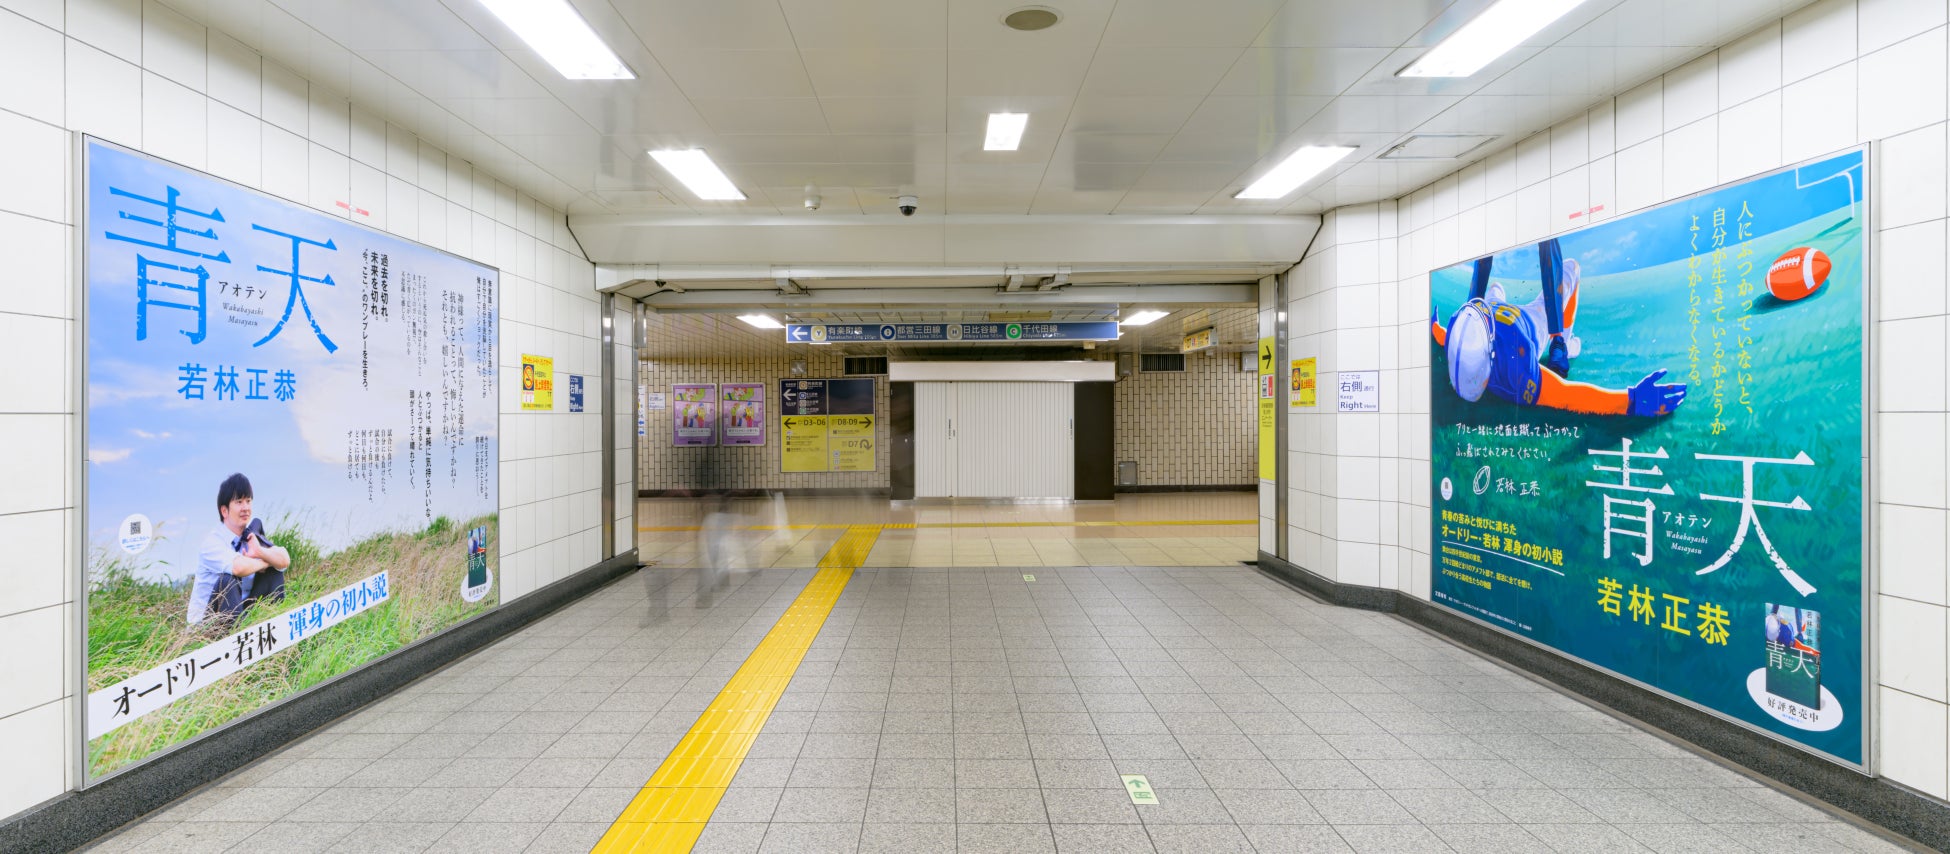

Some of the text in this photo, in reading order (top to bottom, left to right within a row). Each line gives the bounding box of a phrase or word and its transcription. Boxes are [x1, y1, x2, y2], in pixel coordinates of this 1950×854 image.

[105, 185, 338, 354] 青天
[218, 281, 267, 300] アオテン
[371, 251, 379, 320] 未来を切れ。
[222, 302, 264, 316] Wakabayashi
[1688, 215, 1702, 386] よくわからなくなる。
[1737, 201, 1753, 414] 人にぶつかっていないと、
[228, 315, 258, 327] Masayasu
[897, 325, 941, 335] 都営三田線
[963, 325, 998, 334] 日比谷線
[1023, 325, 1058, 334] 千代田線
[1711, 207, 1727, 435] 自分が生きているかどうか
[178, 362, 297, 402] 若林正恭
[1340, 401, 1363, 410] Right
[1441, 509, 1517, 536] 青春の苦みと悦びに満ちた
[1585, 437, 1818, 598] 青天
[1662, 511, 1712, 529] アオテン
[1441, 524, 1564, 567] オードリー・若林 渾身の初小説
[1666, 530, 1709, 545] Wakabayashi
[1670, 541, 1703, 555] Masayasu
[1597, 576, 1731, 646] 若林正恭
[111, 573, 387, 719] オードリー・若林 渾身の初小説
[1765, 640, 1815, 679] 青天
[1767, 696, 1819, 723] 好評発売中
